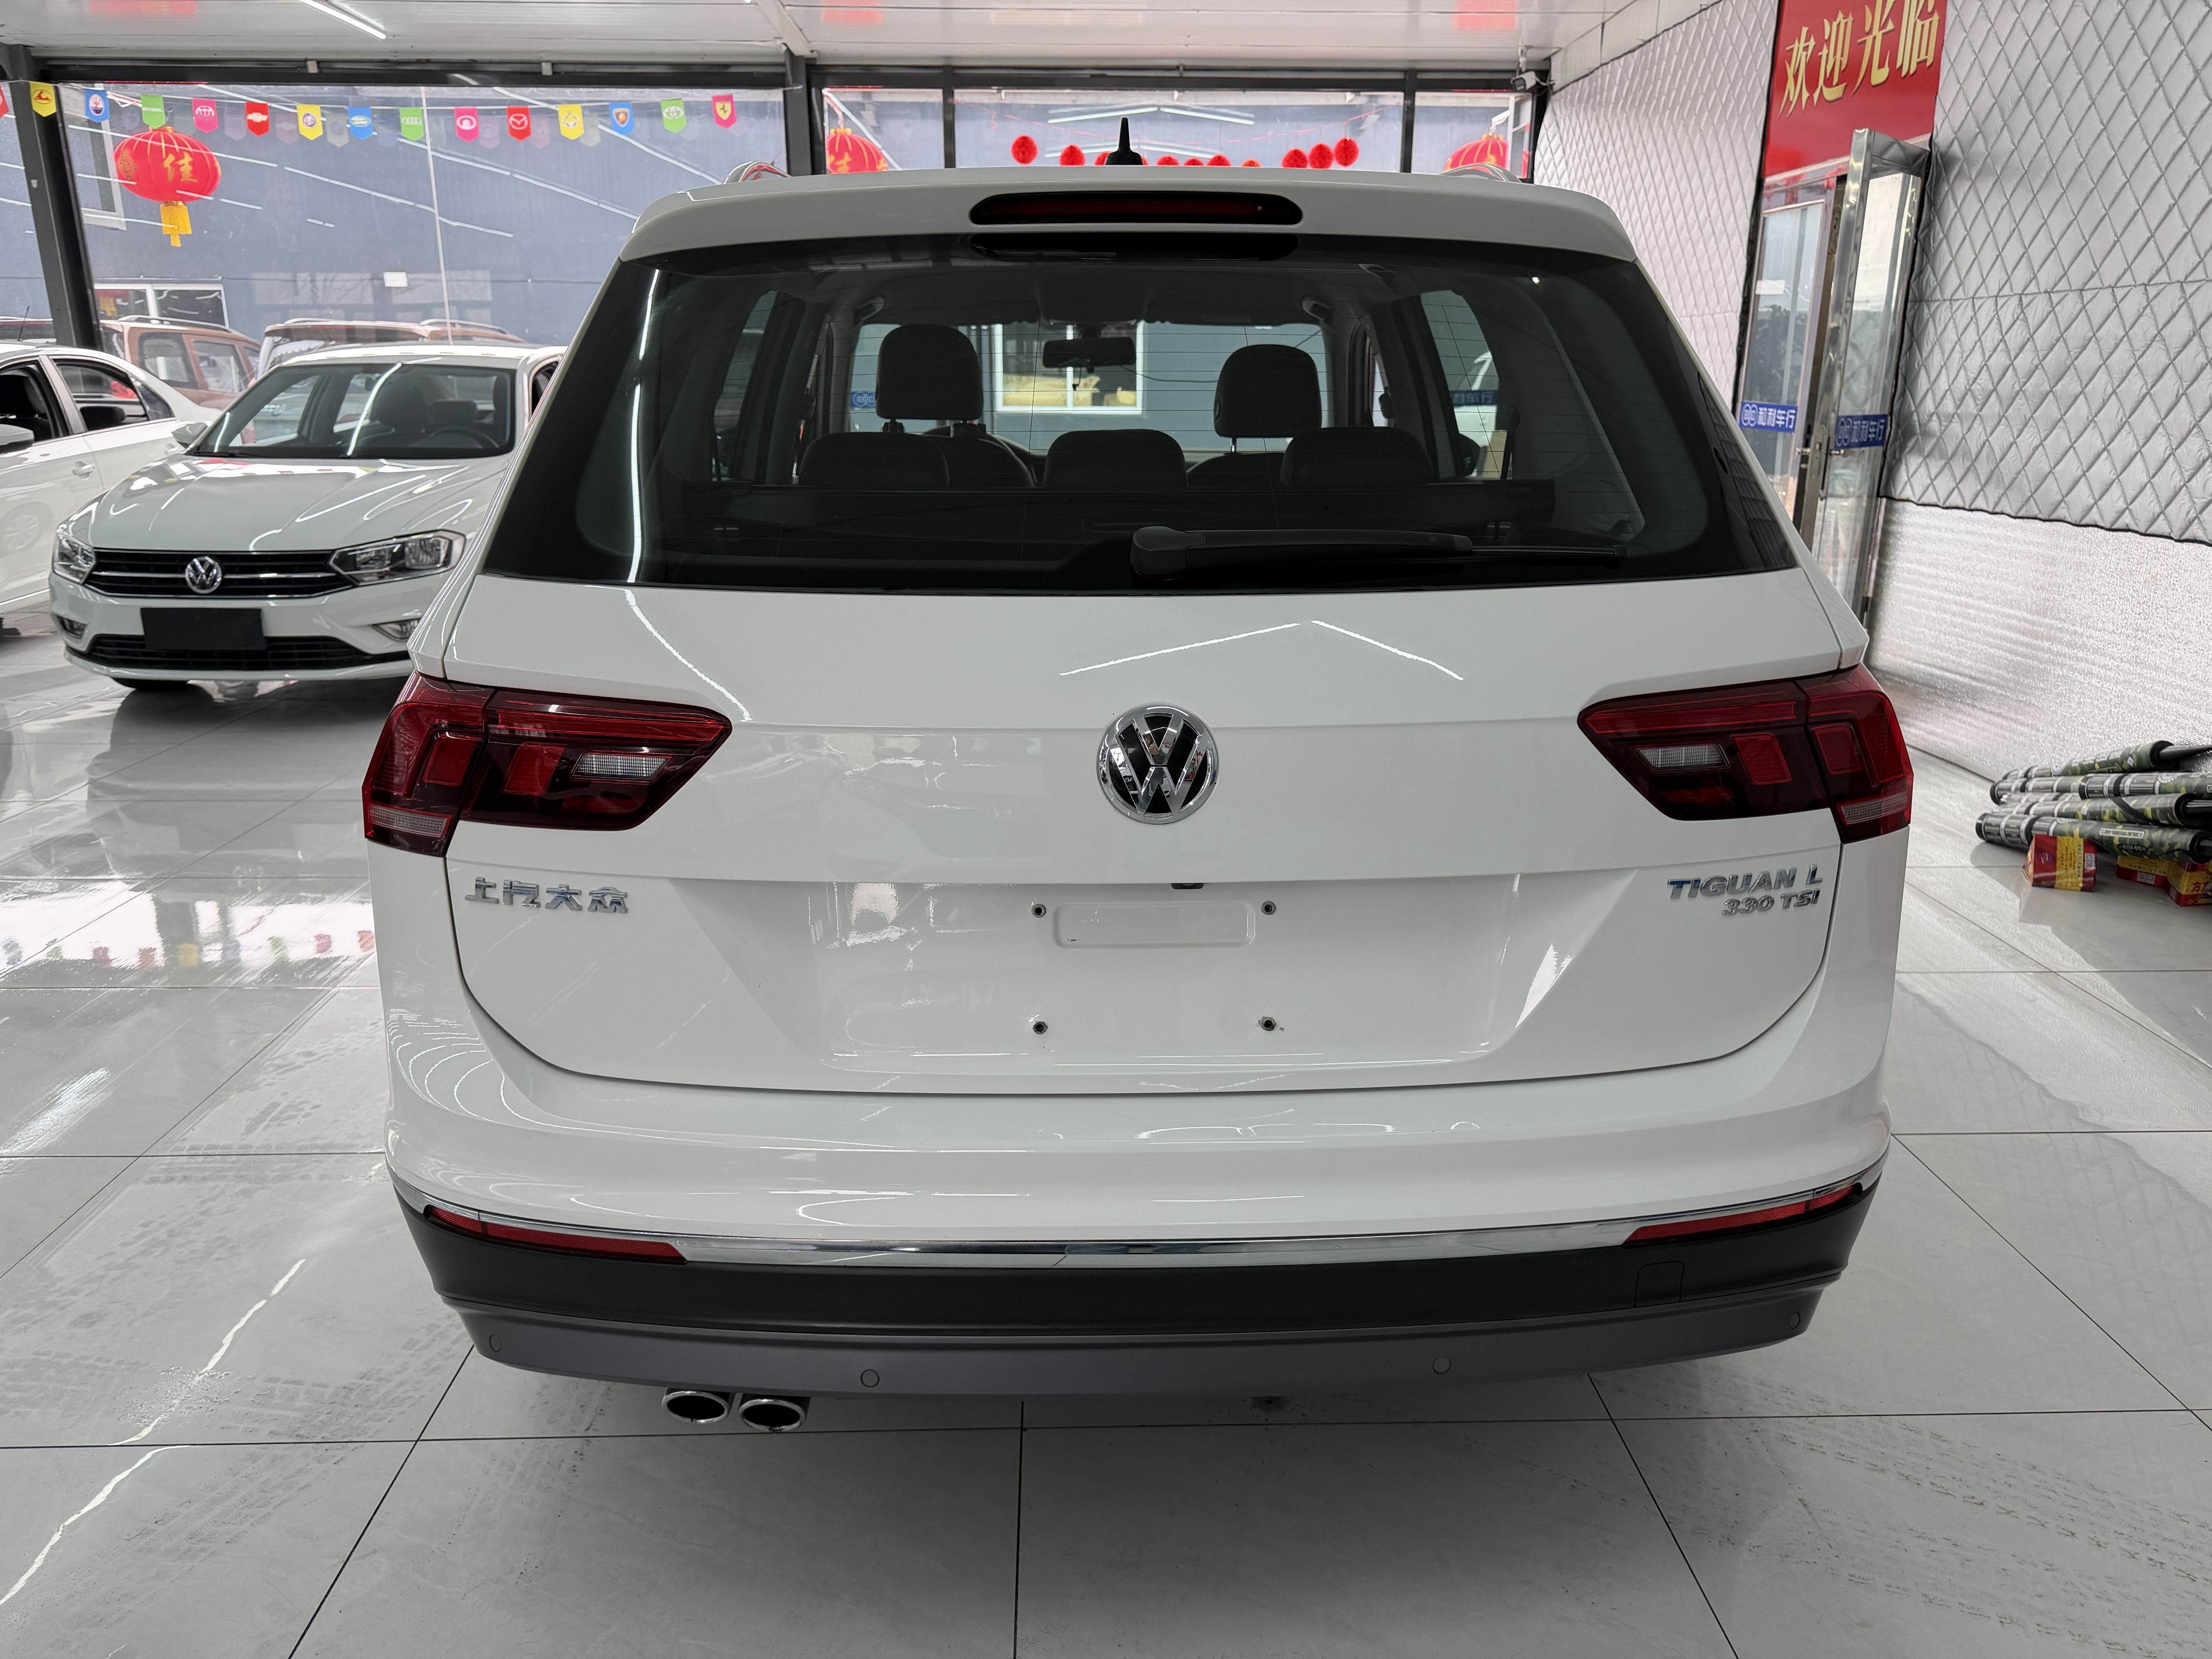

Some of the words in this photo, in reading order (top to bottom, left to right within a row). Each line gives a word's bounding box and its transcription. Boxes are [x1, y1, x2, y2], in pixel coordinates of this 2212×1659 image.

[1778, 0, 1940, 118] 欢迎光临
[162, 151, 198, 183] 佳
[464, 876, 628, 914] 上汽大众
[1667, 866, 1797, 899] TIGUAN
[1806, 864, 1823, 885] L
[1721, 895, 1775, 916] 330
[1780, 888, 1820, 909] TSI
